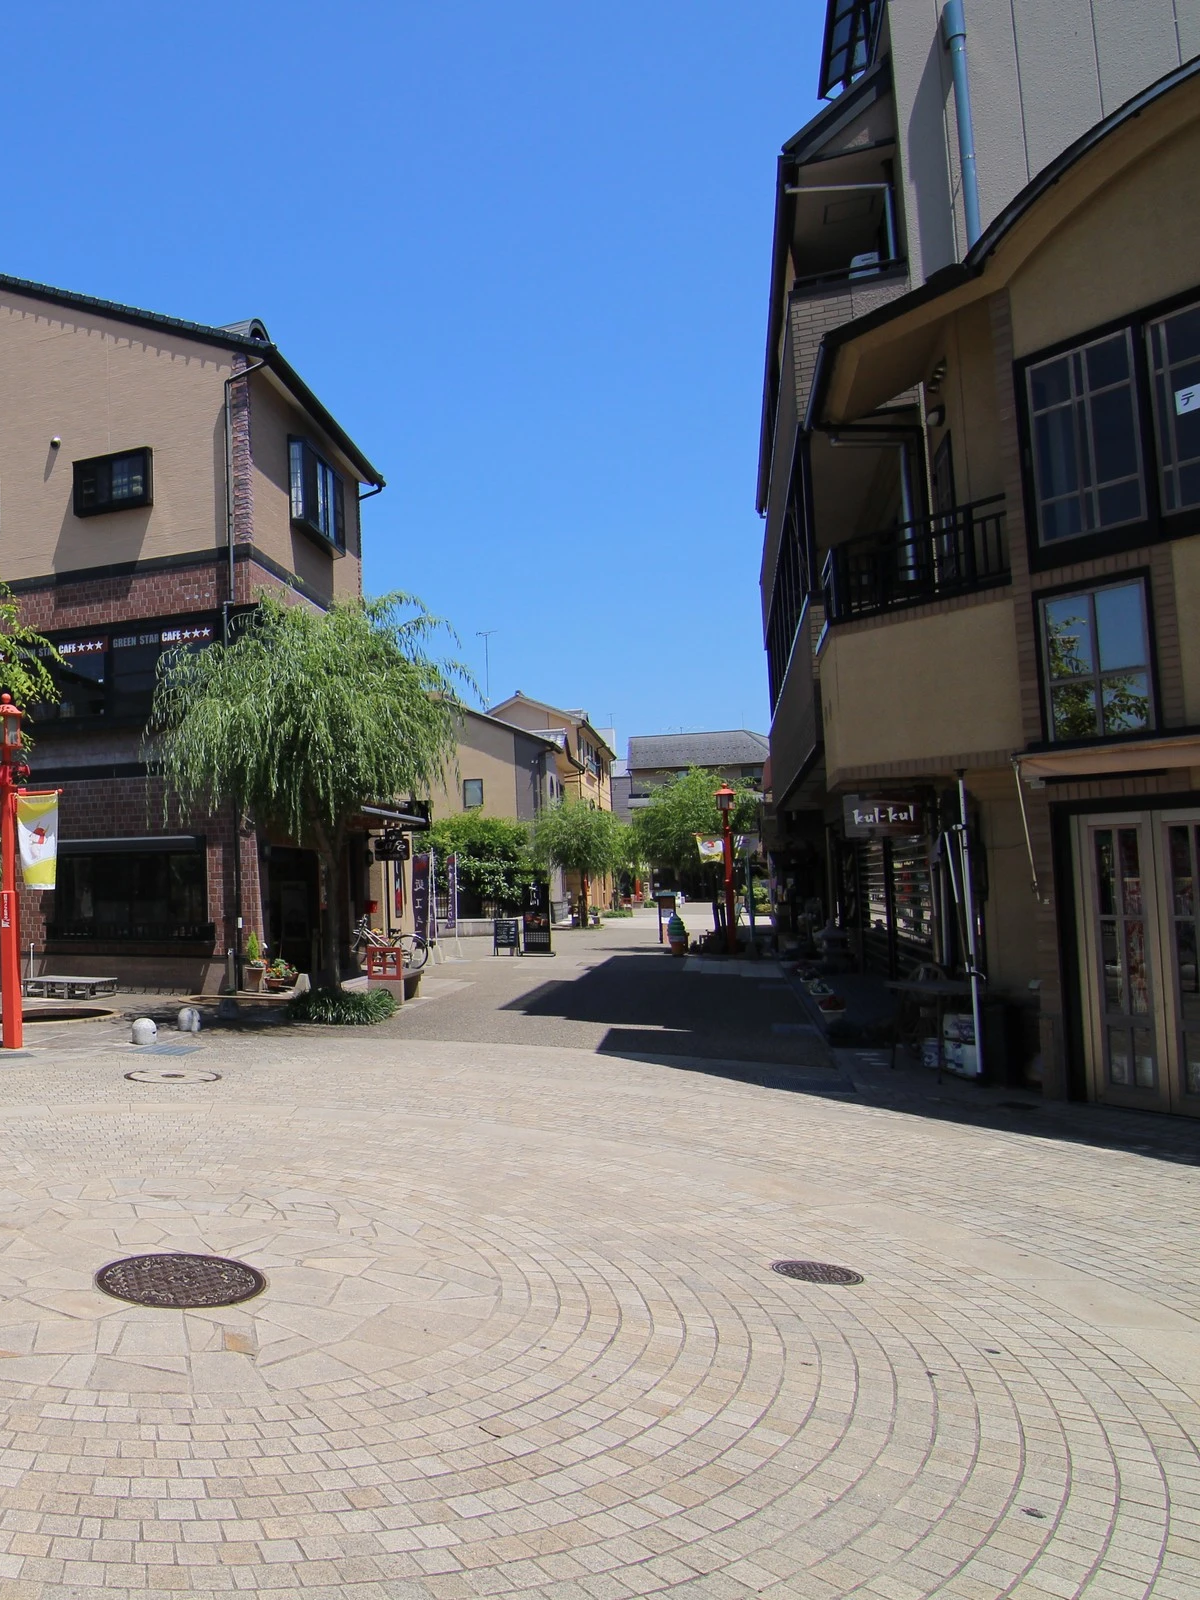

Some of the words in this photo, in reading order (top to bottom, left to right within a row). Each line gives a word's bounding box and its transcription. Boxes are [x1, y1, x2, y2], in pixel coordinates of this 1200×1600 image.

[113, 638, 136, 648] GREEN
[140, 634, 159, 645] STAR
[161, 631, 181, 642] CAFE
[58, 644, 76, 654] CAFE
[852, 805, 914, 825] kul-kul
